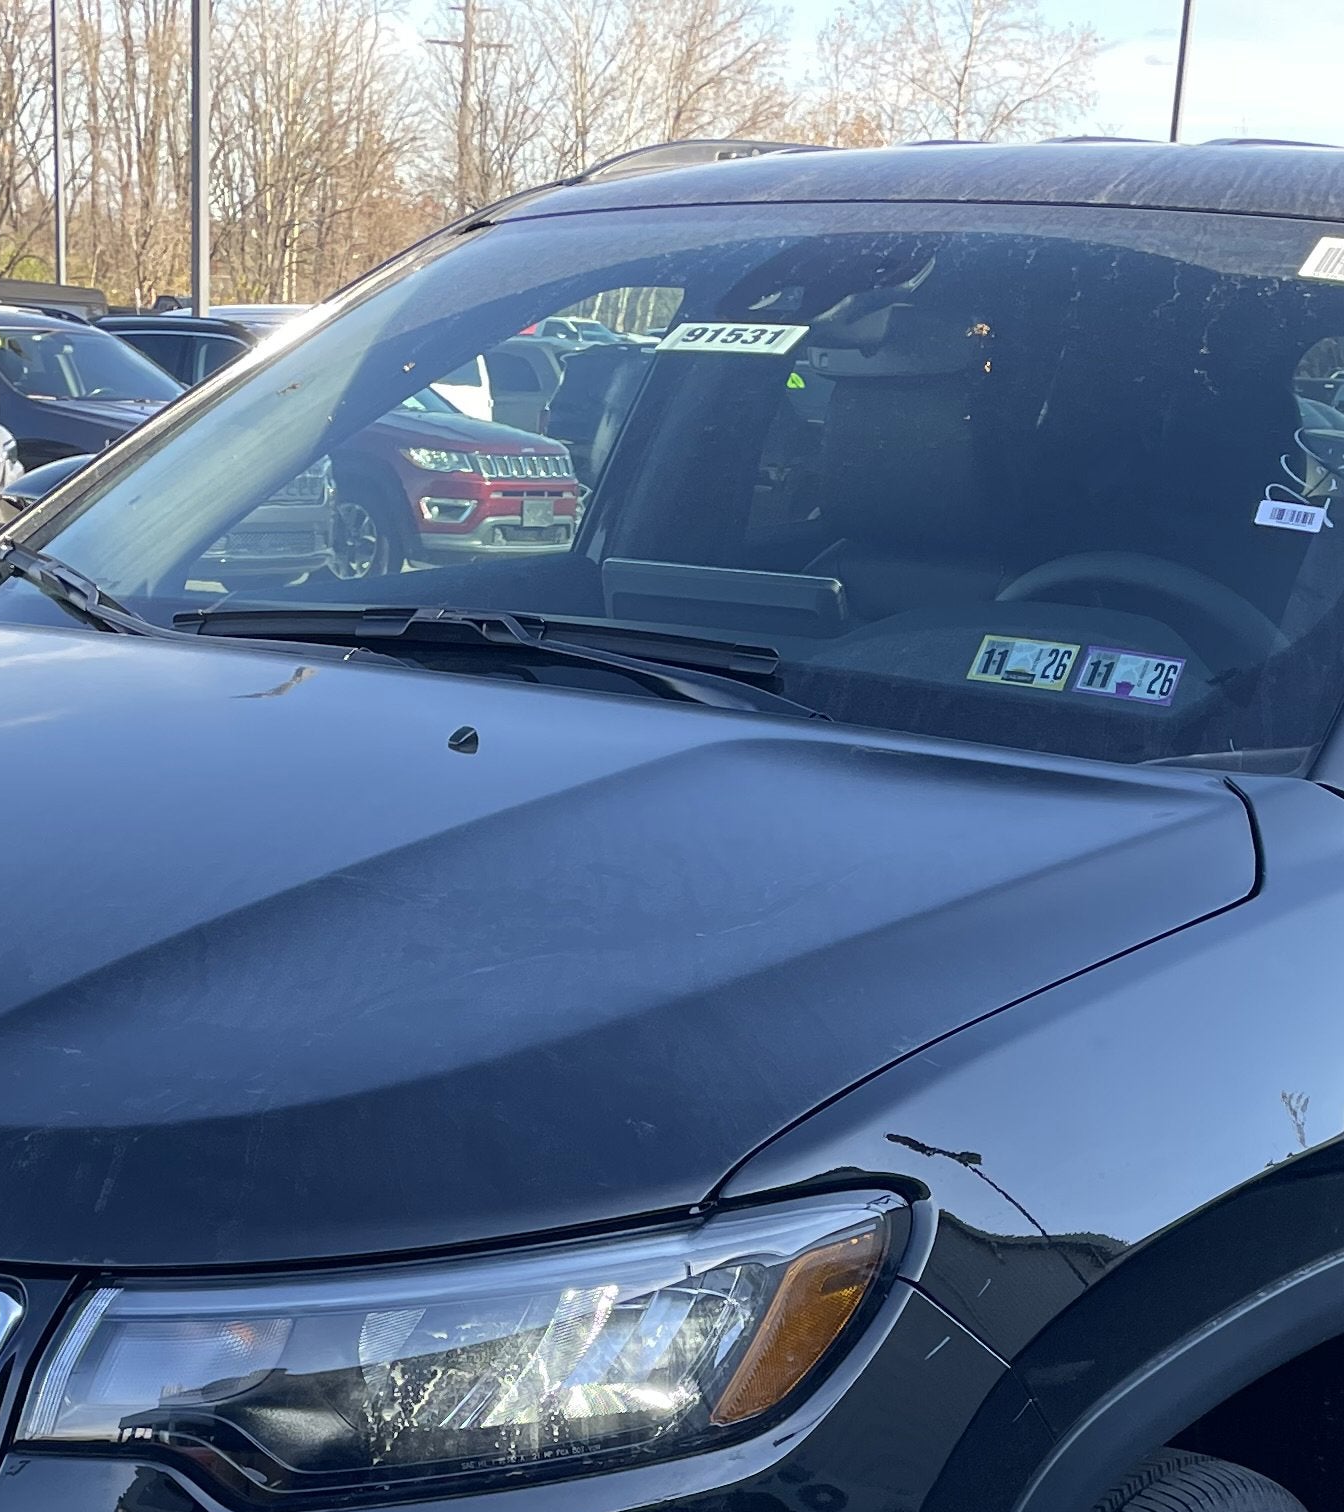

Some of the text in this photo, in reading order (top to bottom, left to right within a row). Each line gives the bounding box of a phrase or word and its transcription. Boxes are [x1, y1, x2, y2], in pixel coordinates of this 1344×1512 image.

[681, 327, 786, 345] 91531
[981, 648, 1010, 676] 11
[1039, 648, 1073, 681] 26
[1086, 659, 1178, 696] 11 26
